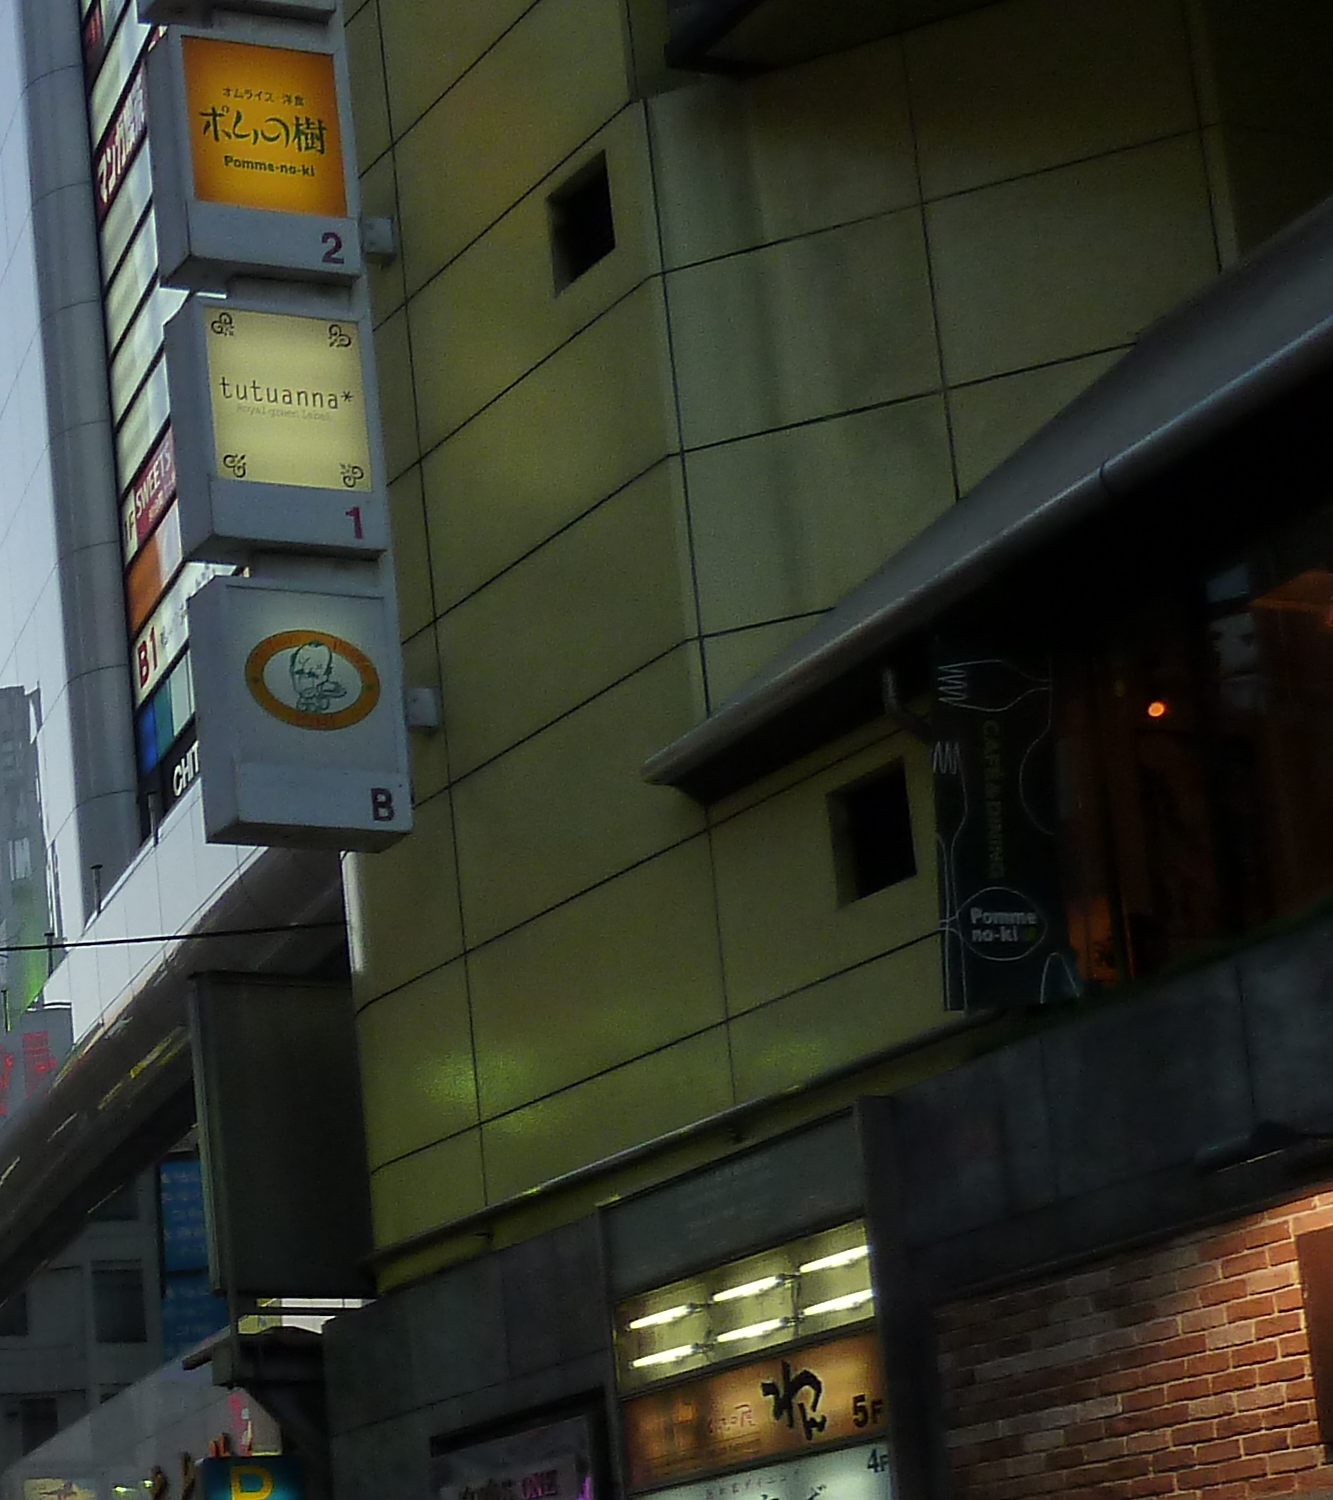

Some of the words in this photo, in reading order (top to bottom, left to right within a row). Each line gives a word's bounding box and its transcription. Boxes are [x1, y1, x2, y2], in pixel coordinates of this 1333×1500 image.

[222, 87, 275, 103] オムライス
[199, 105, 328, 155] ポムの樹
[224, 155, 316, 177] Pomme-no-ki
[321, 231, 345, 265] 2
[135, 445, 172, 520] SWEETS
[346, 507, 364, 540] 1
[137, 626, 160, 689] B1
[370, 787, 397, 824] B
[970, 906, 1037, 926] Pomme
[852, 1394, 884, 1430] 5F
